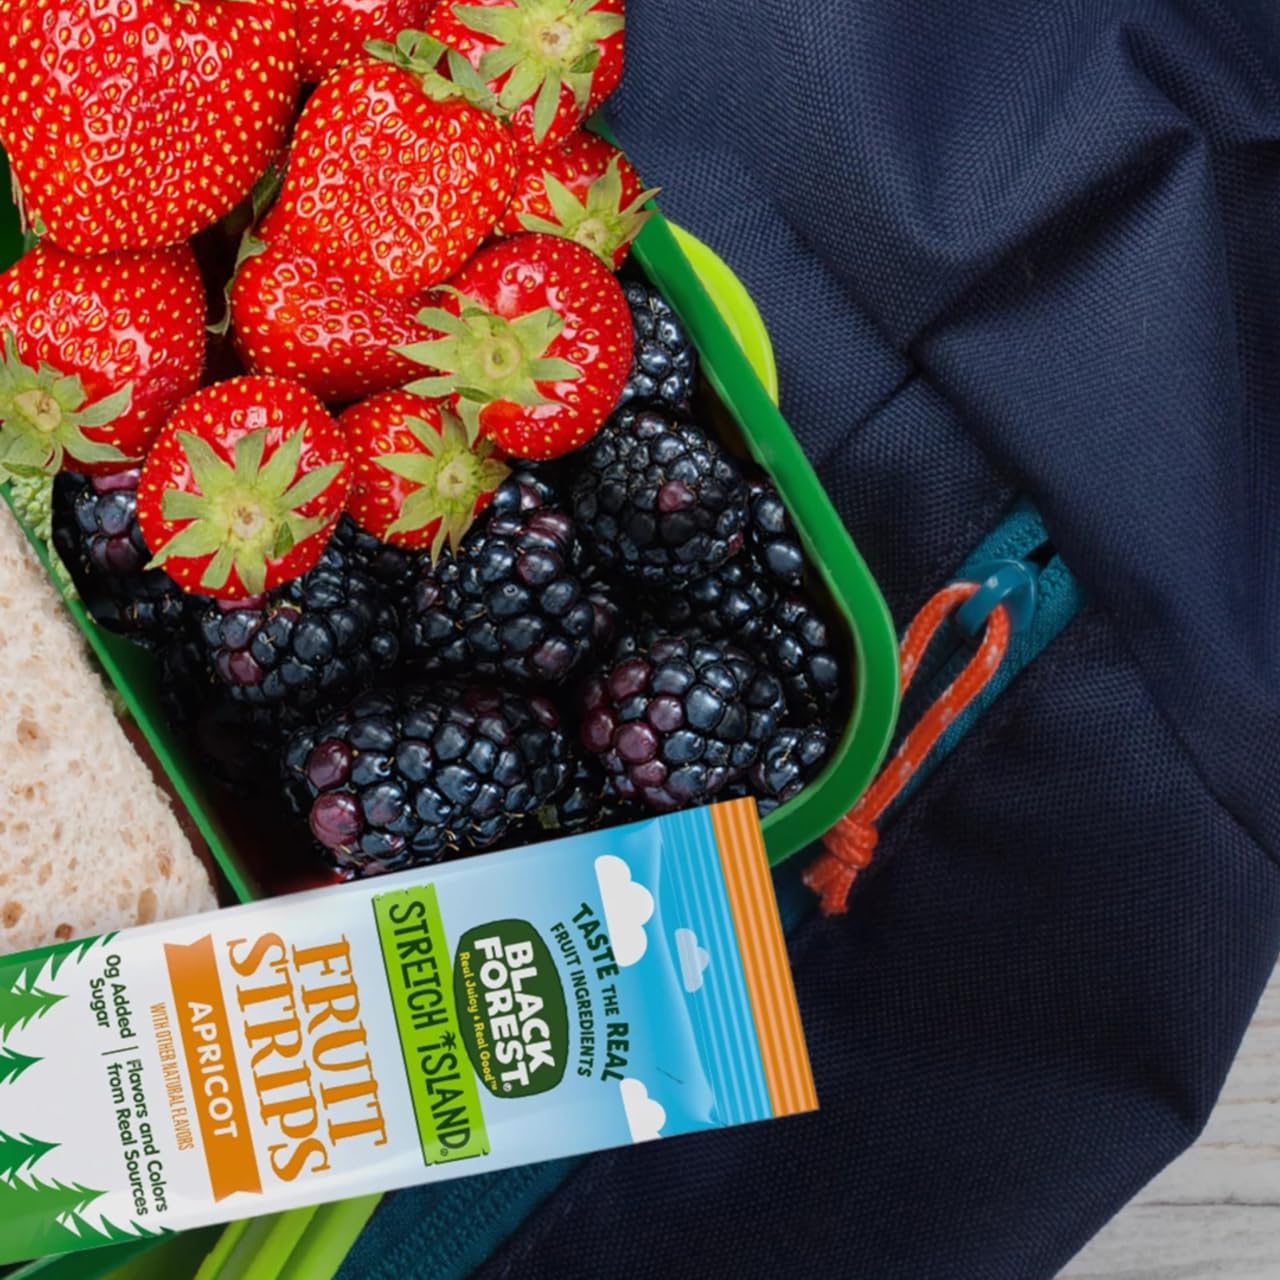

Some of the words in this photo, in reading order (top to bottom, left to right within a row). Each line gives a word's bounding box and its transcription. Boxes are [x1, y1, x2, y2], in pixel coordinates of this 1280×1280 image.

[389, 900, 449, 1030] STRETCH
[459, 951, 473, 977] Real
[572, 902, 619, 979] TASTE
[88, 978, 111, 1026] Sugar
[109, 984, 136, 1039] Added
[149, 1002, 169, 1030] WITH
[464, 978, 478, 1012] Juicy
[504, 940, 555, 1073] BLACK
[549, 922, 580, 965] FRUIT
[570, 970, 593, 1077] INGREDIENTS
[601, 984, 619, 1016] THE
[155, 1030, 176, 1062] OTHER
[226, 932, 330, 1181] STRIPS
[291, 934, 387, 1147] FRUIT
[473, 1022, 487, 1048] Real
[601, 1023, 629, 1081] REAL
[105, 1062, 124, 1104] from
[125, 1059, 149, 1118] Flavors
[161, 1061, 185, 1107] NATURAL
[186, 1002, 238, 1138] APRICOT
[115, 1107, 137, 1146] Real
[138, 1122, 159, 1155] and
[170, 1106, 194, 1151] FLAVORS
[124, 1149, 148, 1216] Sources
[146, 1160, 167, 1212] Colors
